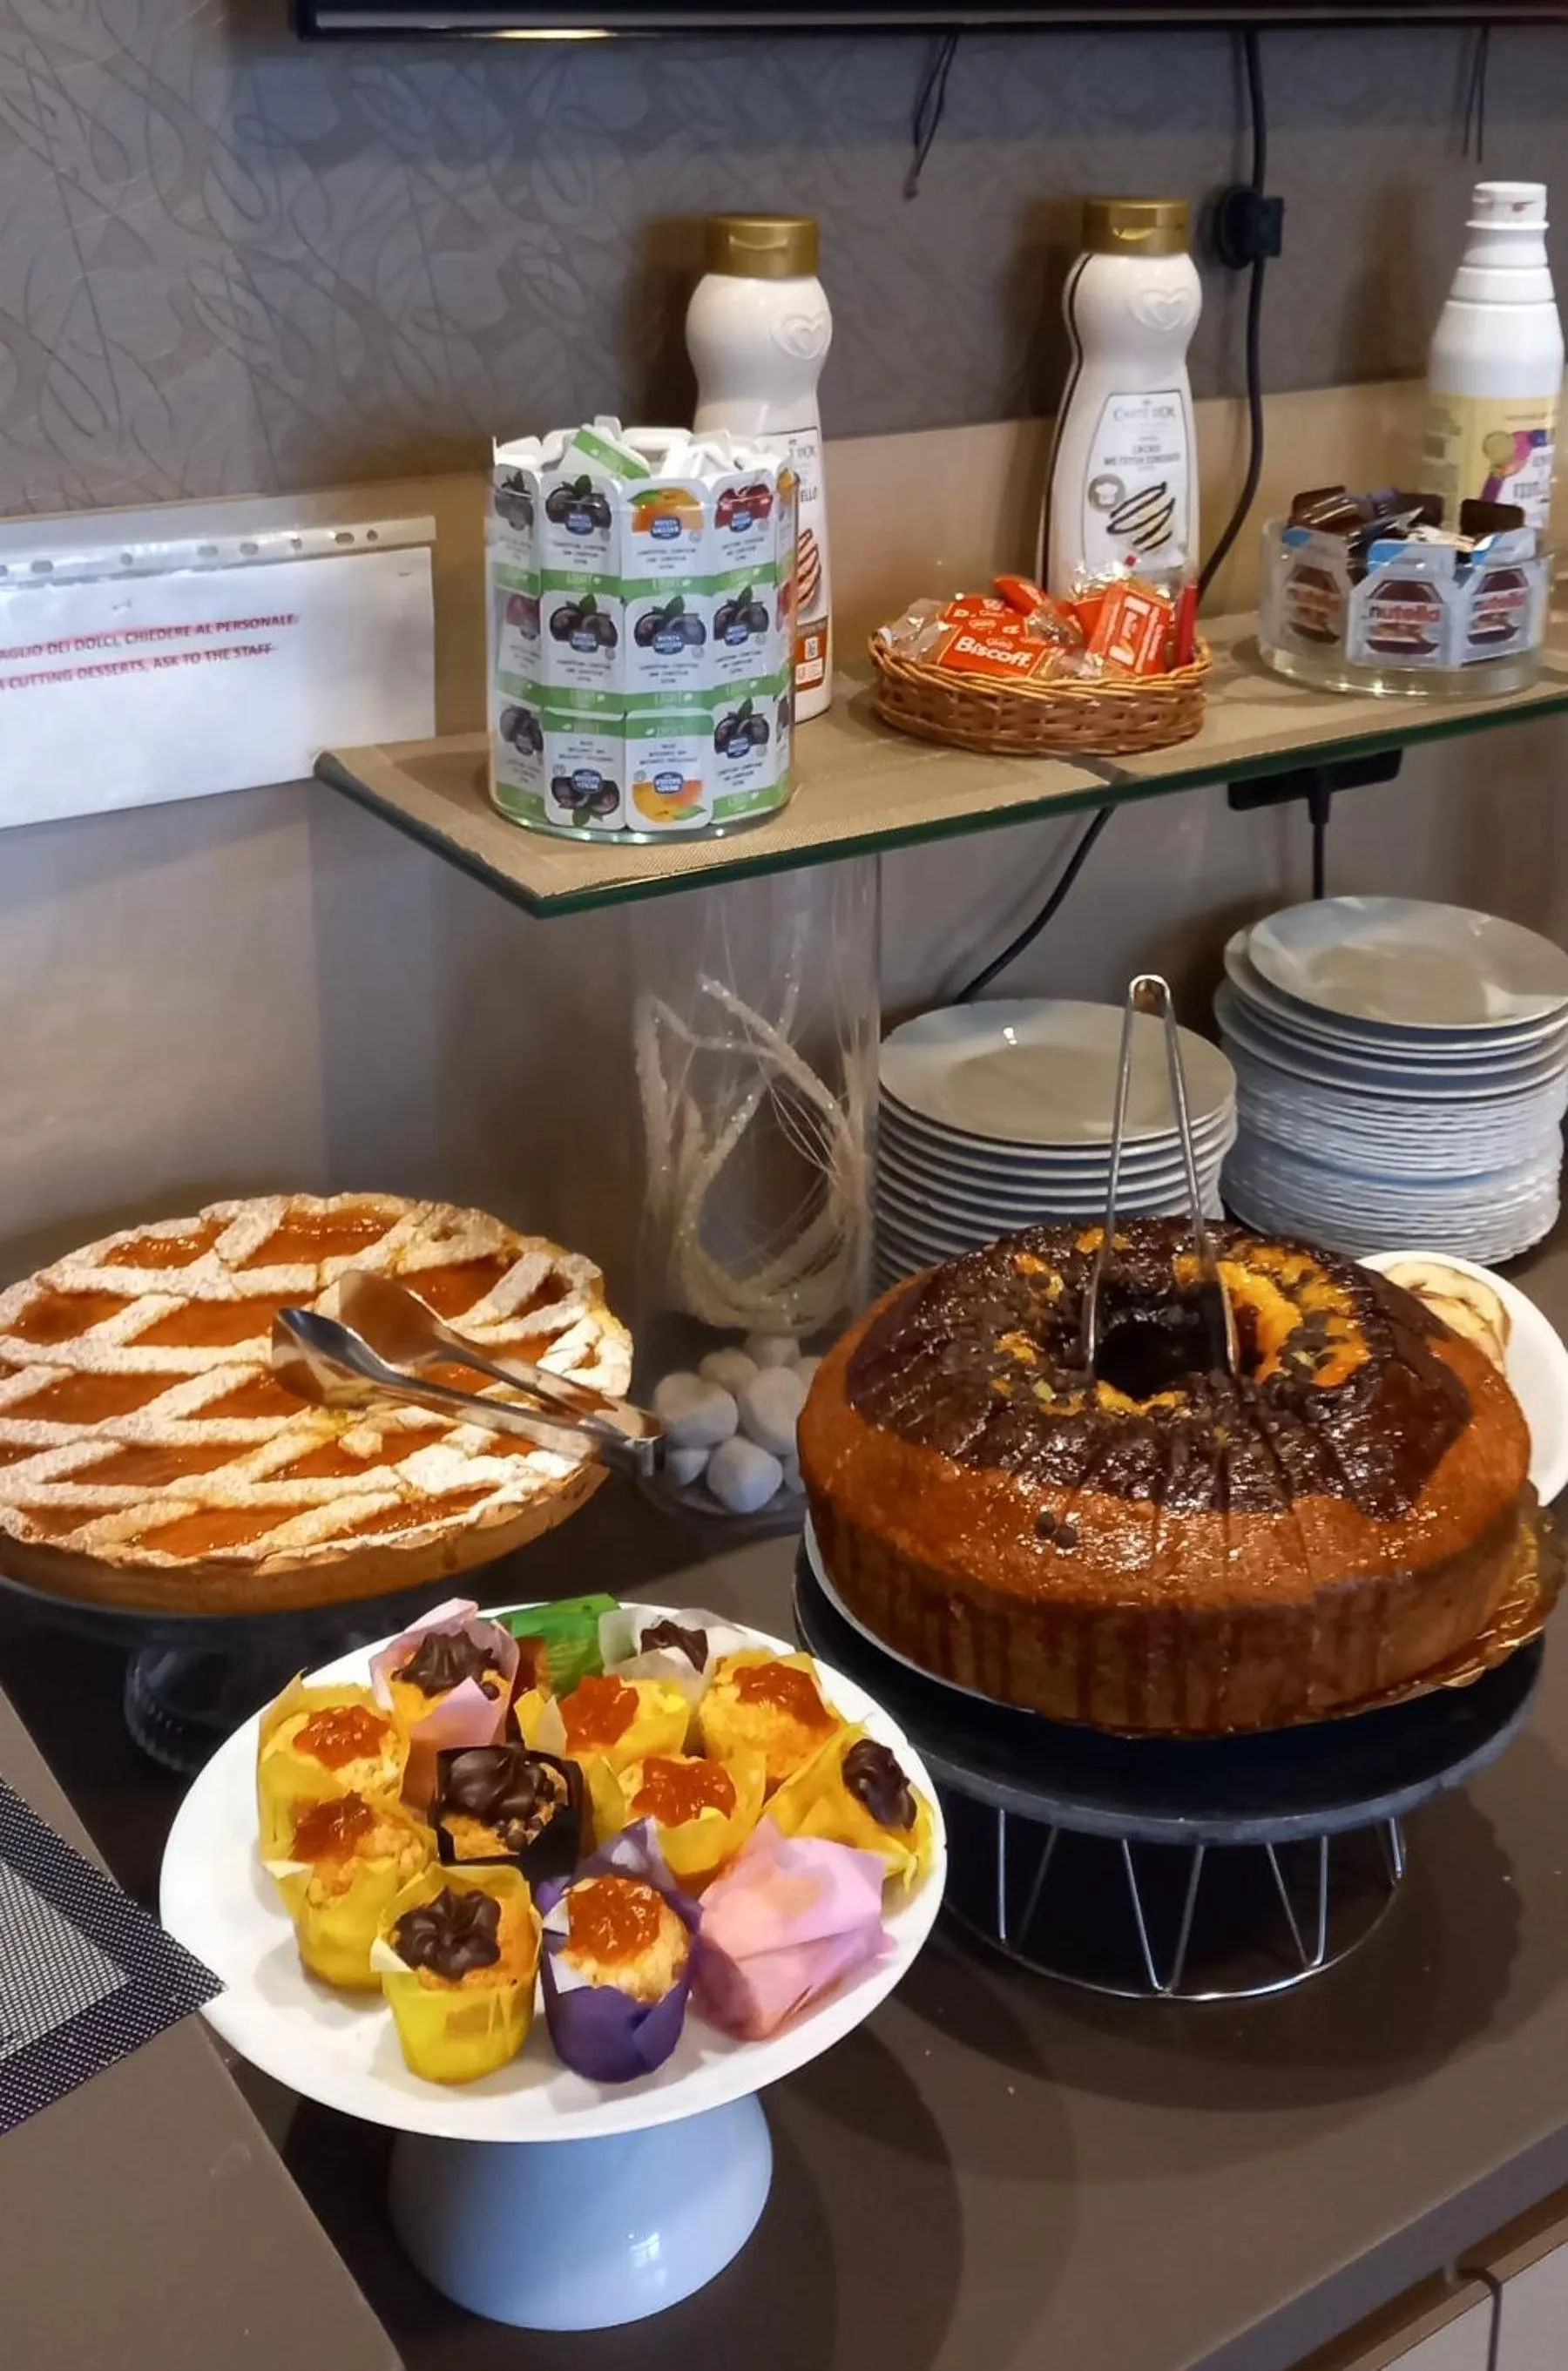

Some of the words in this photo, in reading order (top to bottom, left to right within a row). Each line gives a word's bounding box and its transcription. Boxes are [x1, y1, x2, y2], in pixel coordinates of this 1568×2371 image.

[47, 641, 71, 655] DEI
[125, 625, 191, 645] CHIEDERE
[195, 624, 213, 635] AL
[954, 636, 1034, 669] Biscoff
[10, 669, 73, 690] CUTTING
[153, 655, 179, 669] ASK
[182, 652, 201, 665] TO
[205, 648, 230, 662] THE
[233, 642, 274, 659] STAFF
